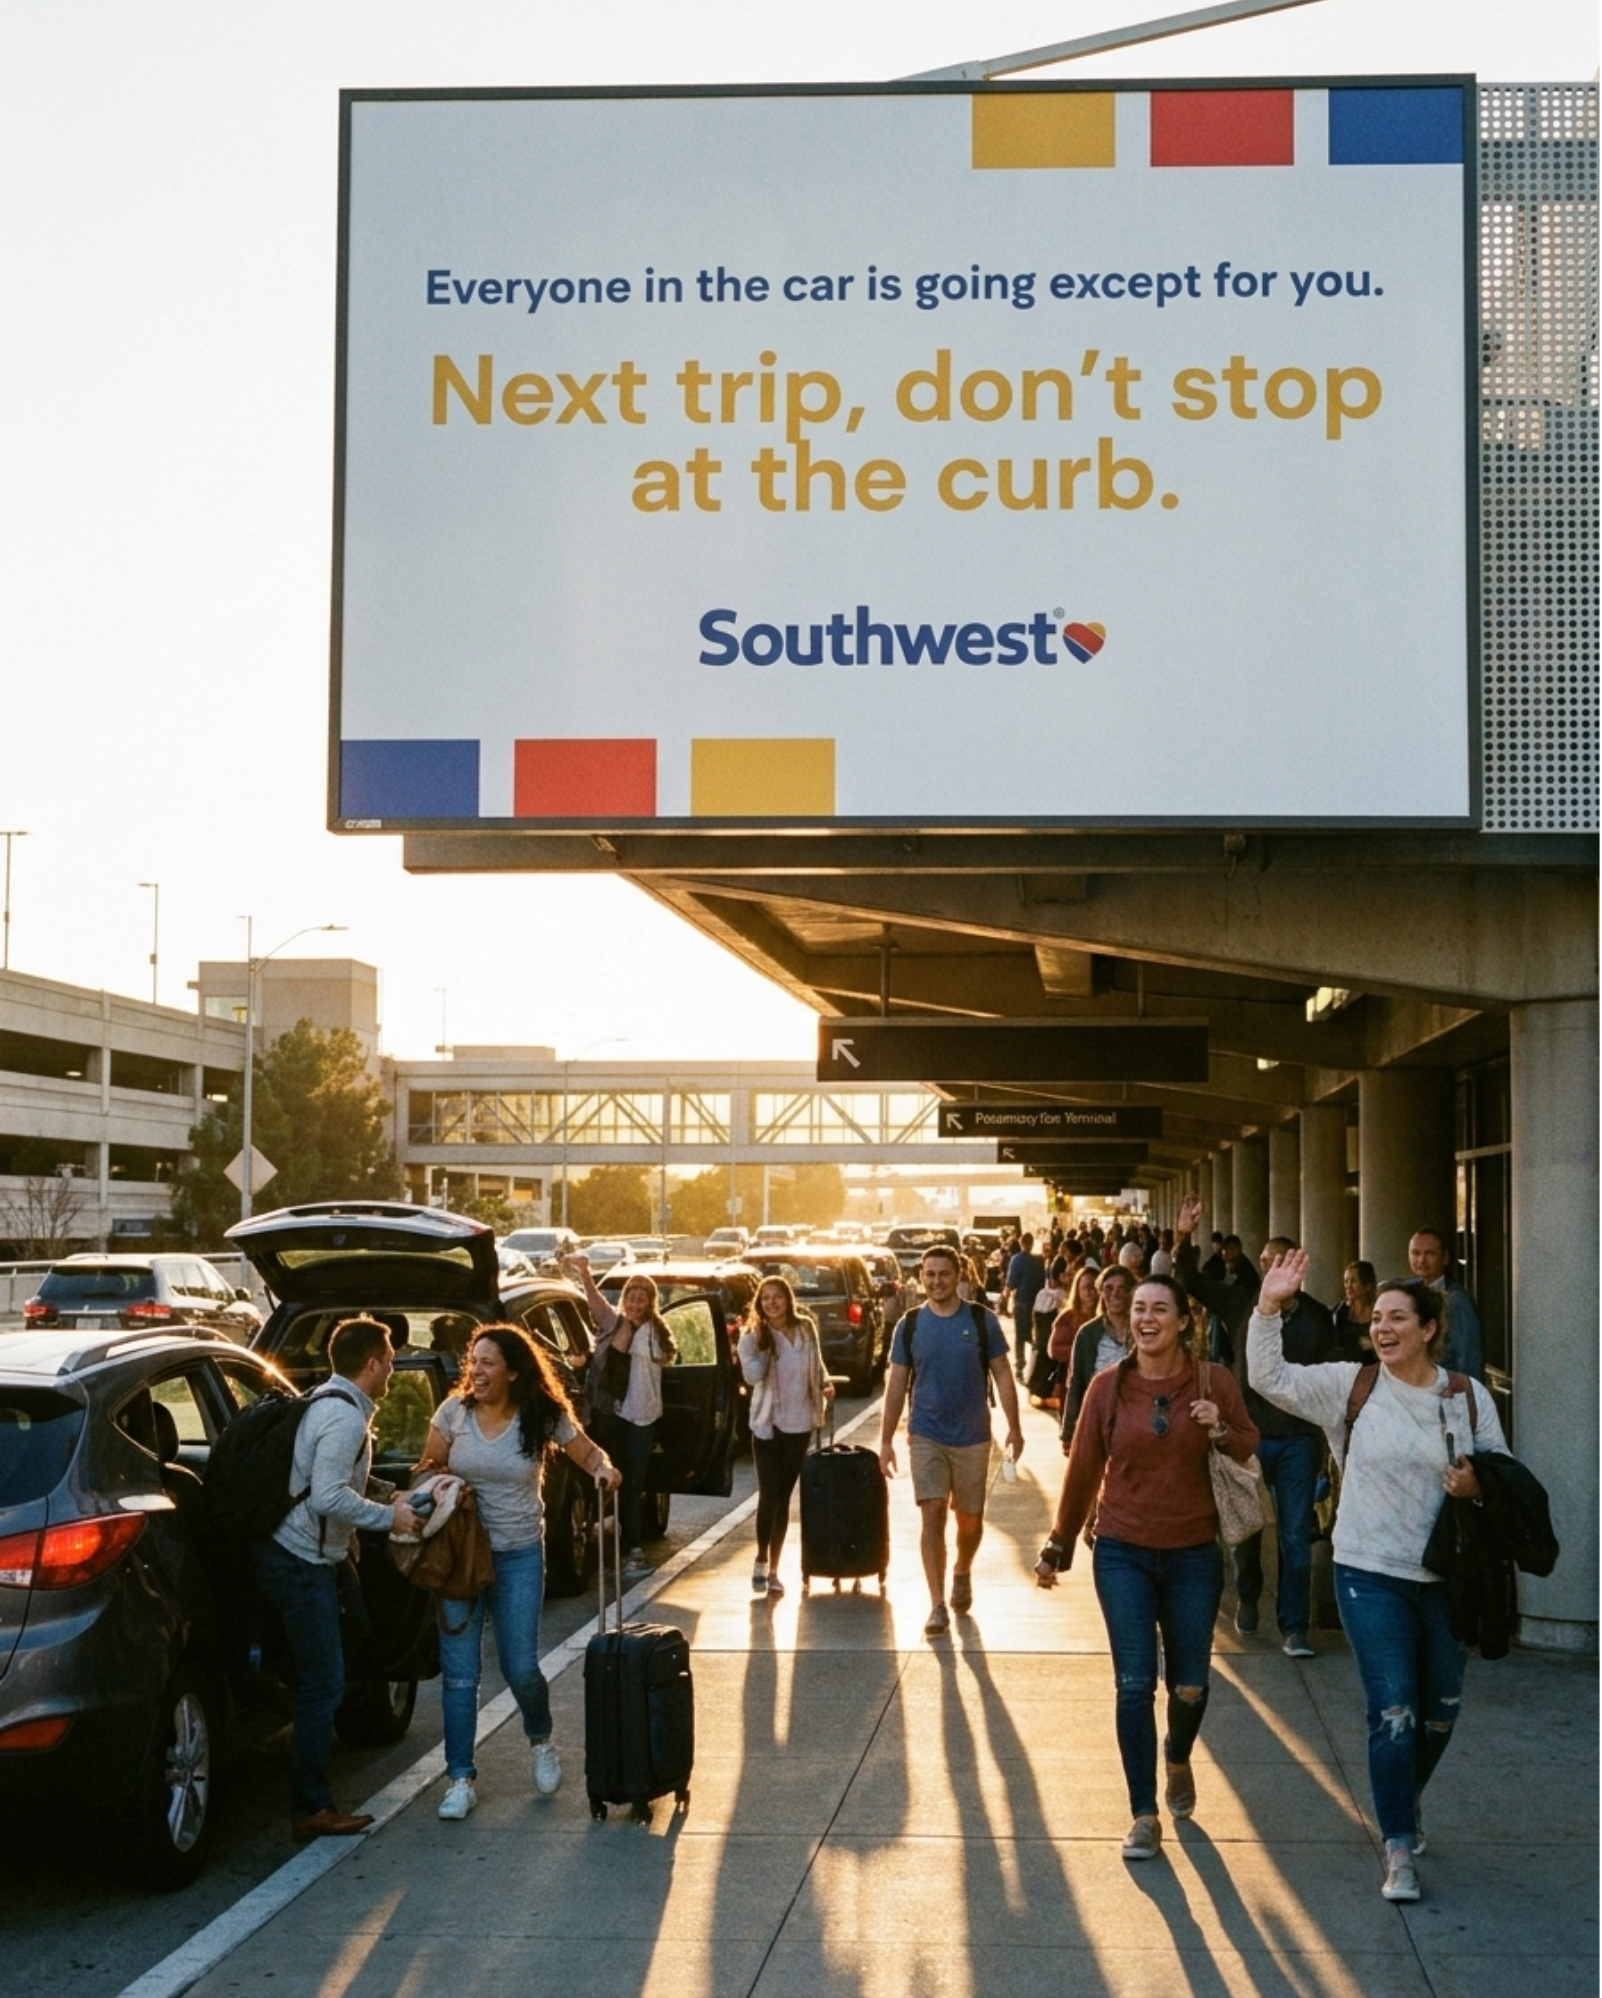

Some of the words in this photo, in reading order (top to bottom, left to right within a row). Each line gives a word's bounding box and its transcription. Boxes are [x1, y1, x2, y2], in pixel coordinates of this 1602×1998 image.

[426, 269, 631, 315] Everyone
[645, 266, 683, 304] in
[695, 266, 770, 303] the
[783, 275, 855, 302] car
[867, 264, 903, 301] is
[915, 263, 1037, 311] going
[1049, 265, 1202, 309] except
[1213, 260, 1278, 298] for
[1289, 270, 1384, 307] you.
[432, 354, 647, 426] Next
[675, 350, 864, 444] trip,
[895, 349, 1141, 423] don’t
[1173, 355, 1382, 441] stop
[631, 447, 722, 513] at
[750, 438, 907, 513] the
[937, 436, 1179, 513] curb.
